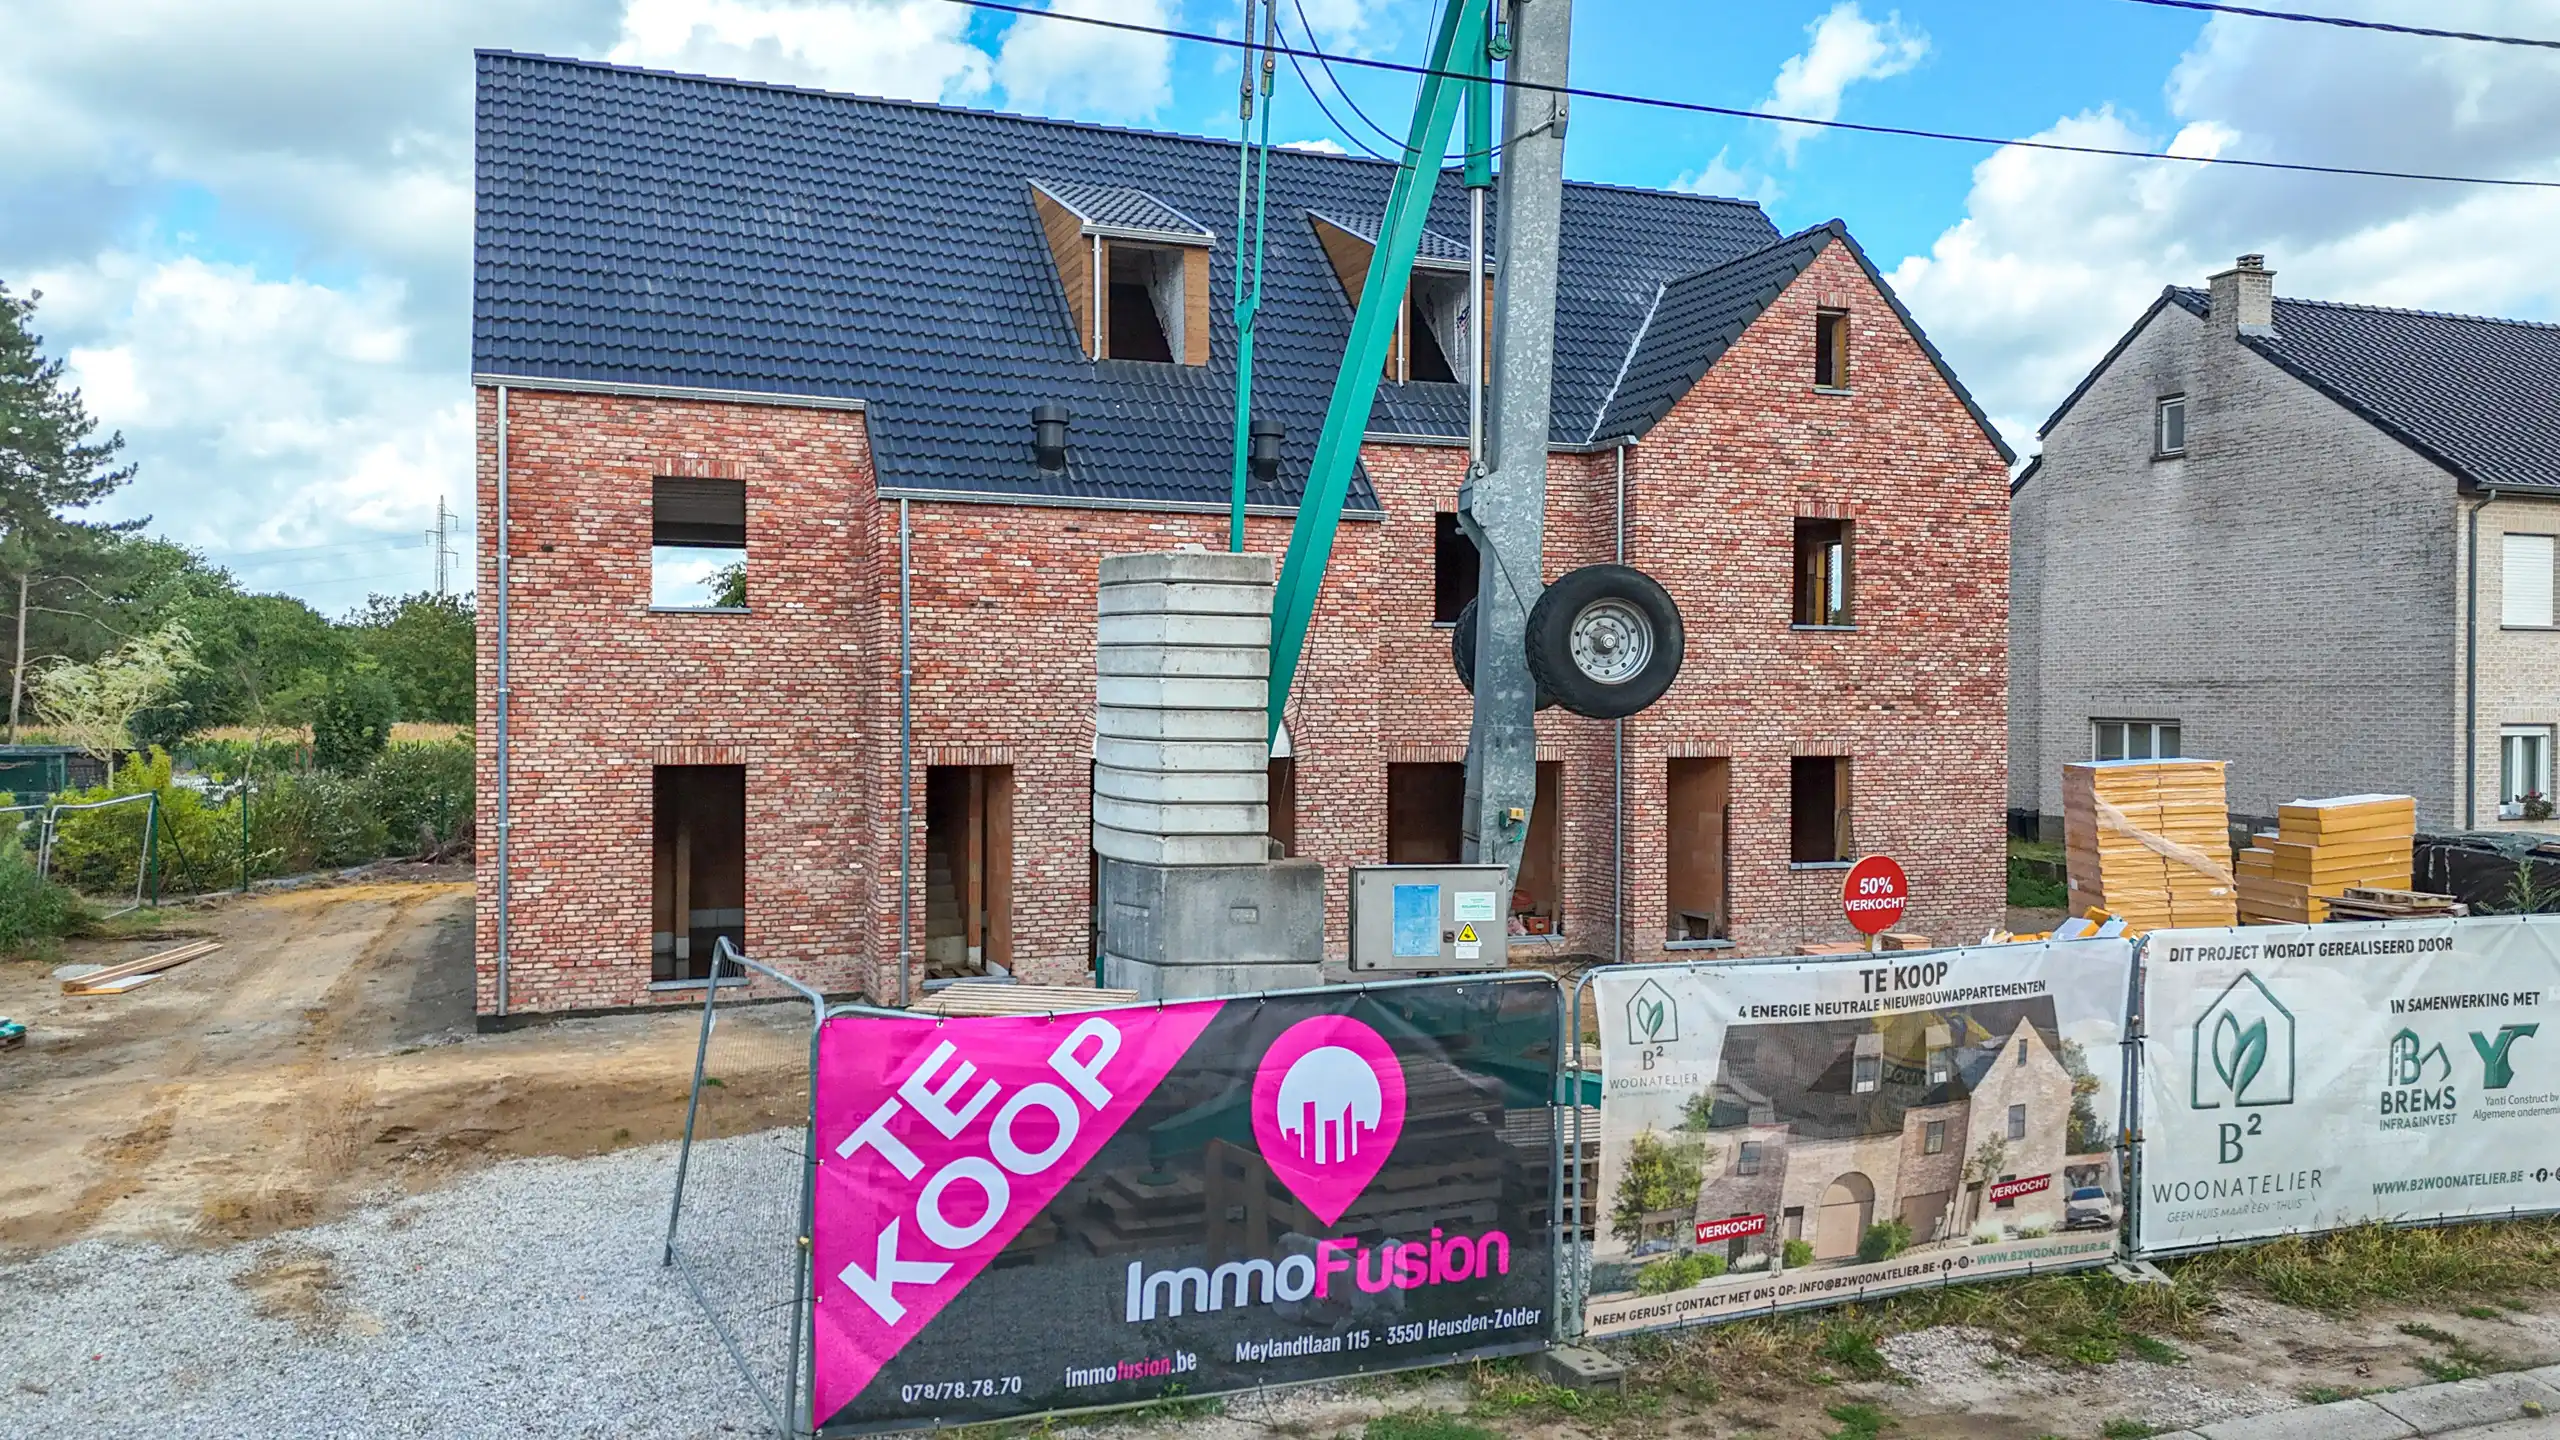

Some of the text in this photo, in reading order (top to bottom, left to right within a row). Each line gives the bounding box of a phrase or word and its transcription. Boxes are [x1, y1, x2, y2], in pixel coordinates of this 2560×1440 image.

[1860, 877, 1893, 894] 50%
[1845, 897, 1906, 911] VERKOCHT
[2169, 937, 2453, 962] DIT PROJECT WORDT GEREALISEERD DOOR
[1859, 961, 1948, 994] TE KOOP
[1738, 980, 2046, 1019] 4 ENERGIE NEUTRALE NIEUWBOUWAPPARTEMENTEN
[2390, 991, 2540, 1014] IN SAMENWERKING MET
[1609, 1073, 1698, 1090] WOONATELIER
[835, 1039, 1002, 1181] TE
[2380, 1085, 2456, 1115] BREMS
[2485, 1096, 2506, 1106] Yanti
[2508, 1093, 2548, 1105] Construct
[2379, 1113, 2457, 1131] INFRA&INVEST
[2473, 1108, 2516, 1121] Algemene
[837, 1017, 1121, 1327] KOOP
[2372, 1170, 2524, 1195] WWW.B2WOONATELIER.BE
[1990, 1177, 2051, 1199] VERKOCHT
[2152, 1169, 2322, 1204] WOONATELIER
[2167, 1209, 2194, 1223] GEEN
[2196, 1203, 2219, 1219] HUIS
[2220, 1199, 2249, 1217] MAAR
[2251, 1201, 2269, 1214] EEN
[1698, 1218, 1764, 1240] VERKOCHT
[1126, 1227, 1509, 1323] ImmoFusion
[1593, 1312, 1626, 1326] NEEM
[1629, 1304, 1672, 1321] GERUST
[1675, 1294, 1726, 1312] CONTACT
[1728, 1290, 1750, 1305] MET
[1753, 1286, 1775, 1300] ONS
[1778, 1283, 1796, 1297] OP:
[1799, 1262, 1936, 1294] INFO@B2WOONATELIER.BE
[1236, 1336, 1340, 1364] Meylandtlaan
[1346, 1331, 1370, 1352] 115
[1387, 1323, 1424, 1345] 3550
[1428, 1308, 1541, 1337] Heusden-Zolder
[1066, 1350, 1197, 1388] immofusion.be
[902, 1376, 1022, 1402] 078/78.78.70
